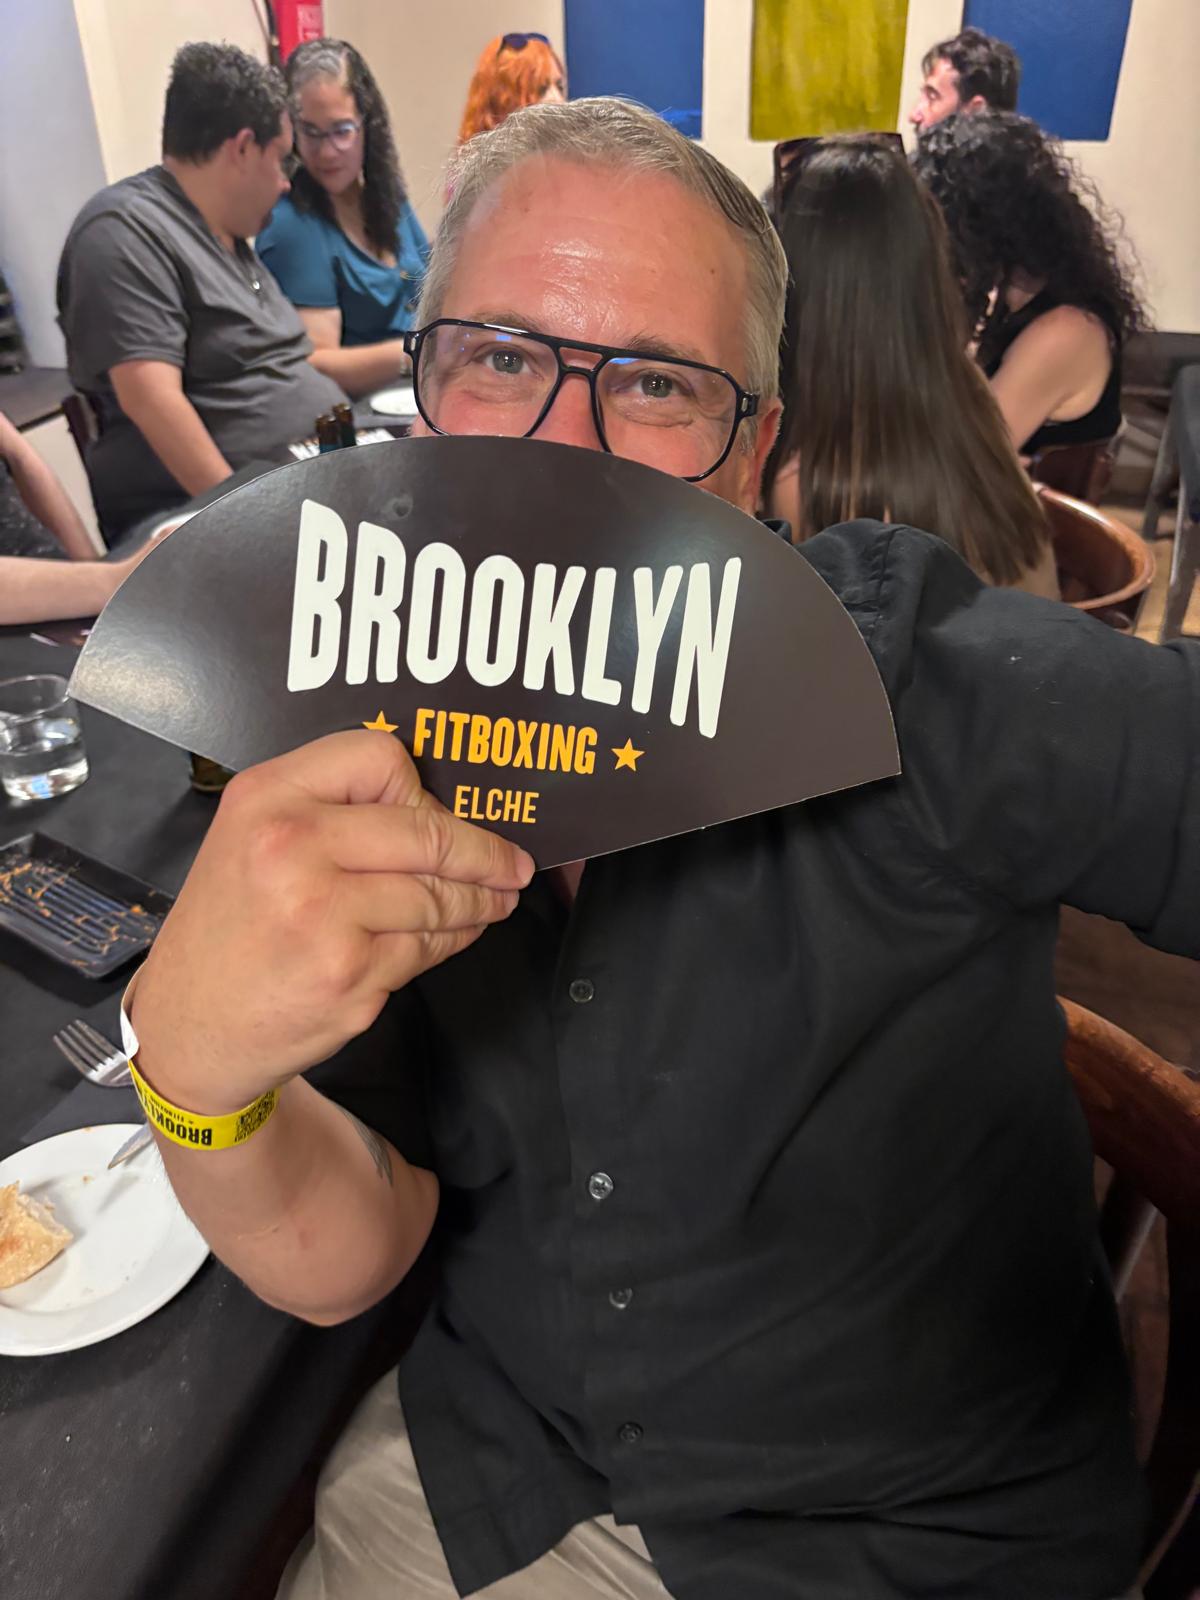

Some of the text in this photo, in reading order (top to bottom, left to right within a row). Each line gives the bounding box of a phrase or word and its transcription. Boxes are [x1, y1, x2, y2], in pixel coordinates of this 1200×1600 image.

[287, 498, 742, 739] BROOKLYN
[413, 707, 598, 775] FITBOXING
[454, 785, 540, 824] ELCHE
